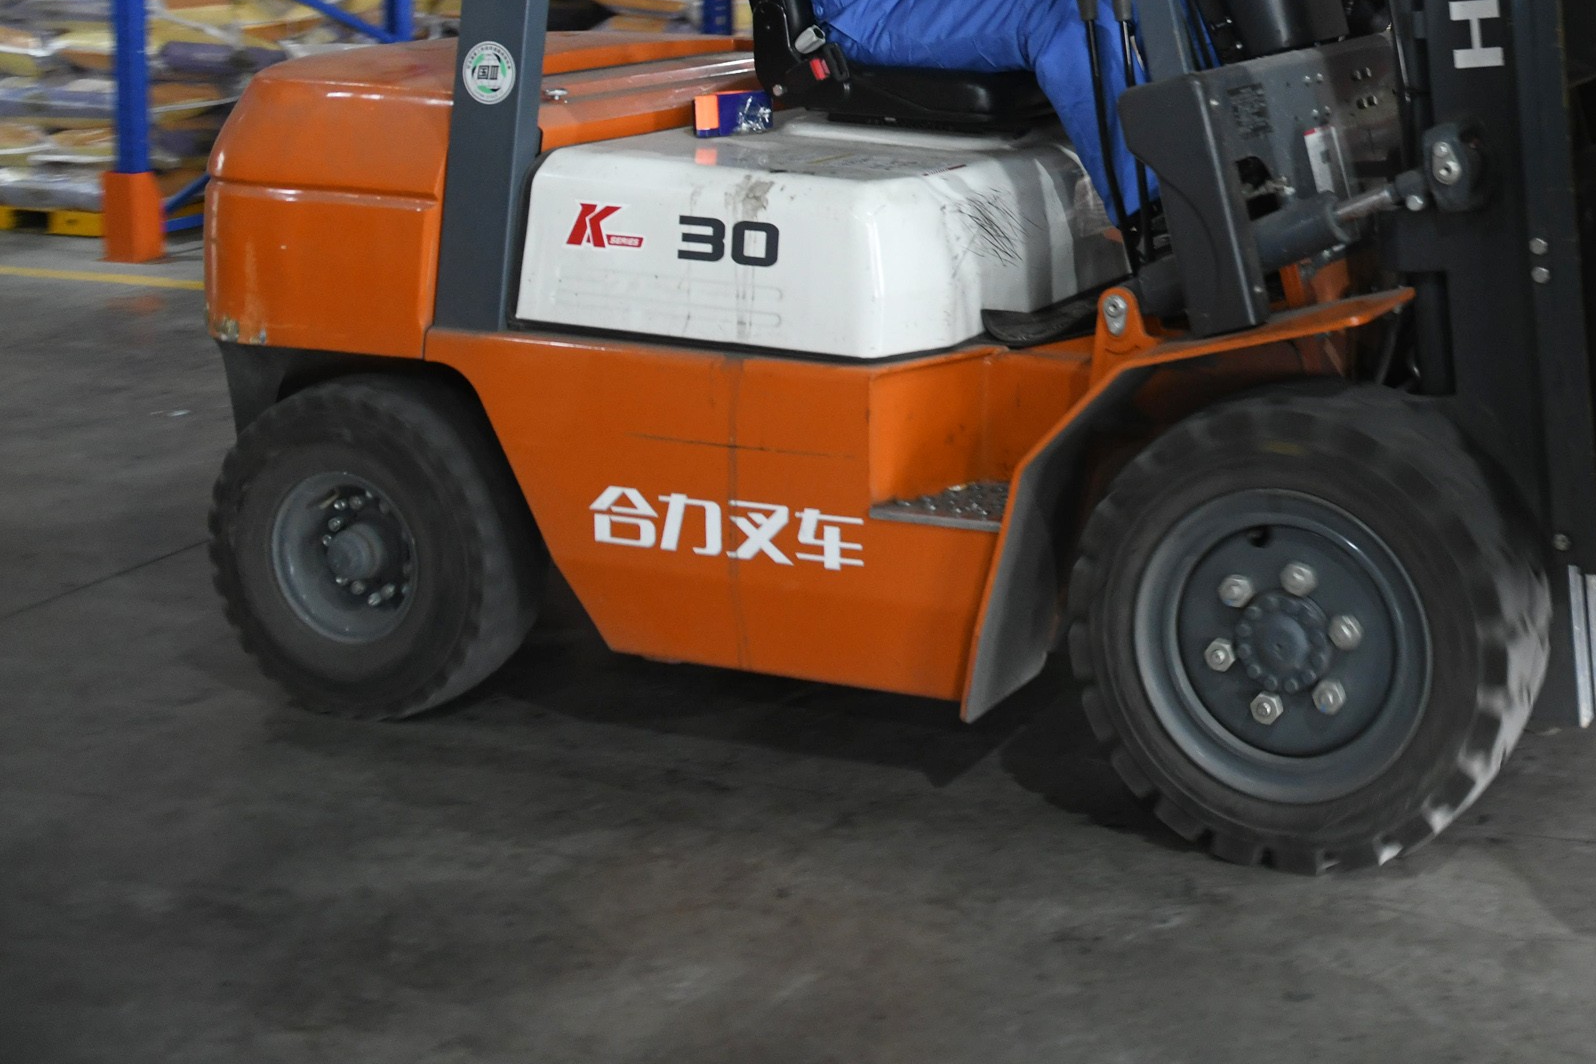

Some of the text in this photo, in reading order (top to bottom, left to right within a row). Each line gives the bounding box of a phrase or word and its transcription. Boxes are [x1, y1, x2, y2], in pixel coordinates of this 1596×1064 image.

[566, 203, 640, 248] K SERIES
[677, 214, 780, 267] 30
[589, 485, 864, 570] 合力叉车
